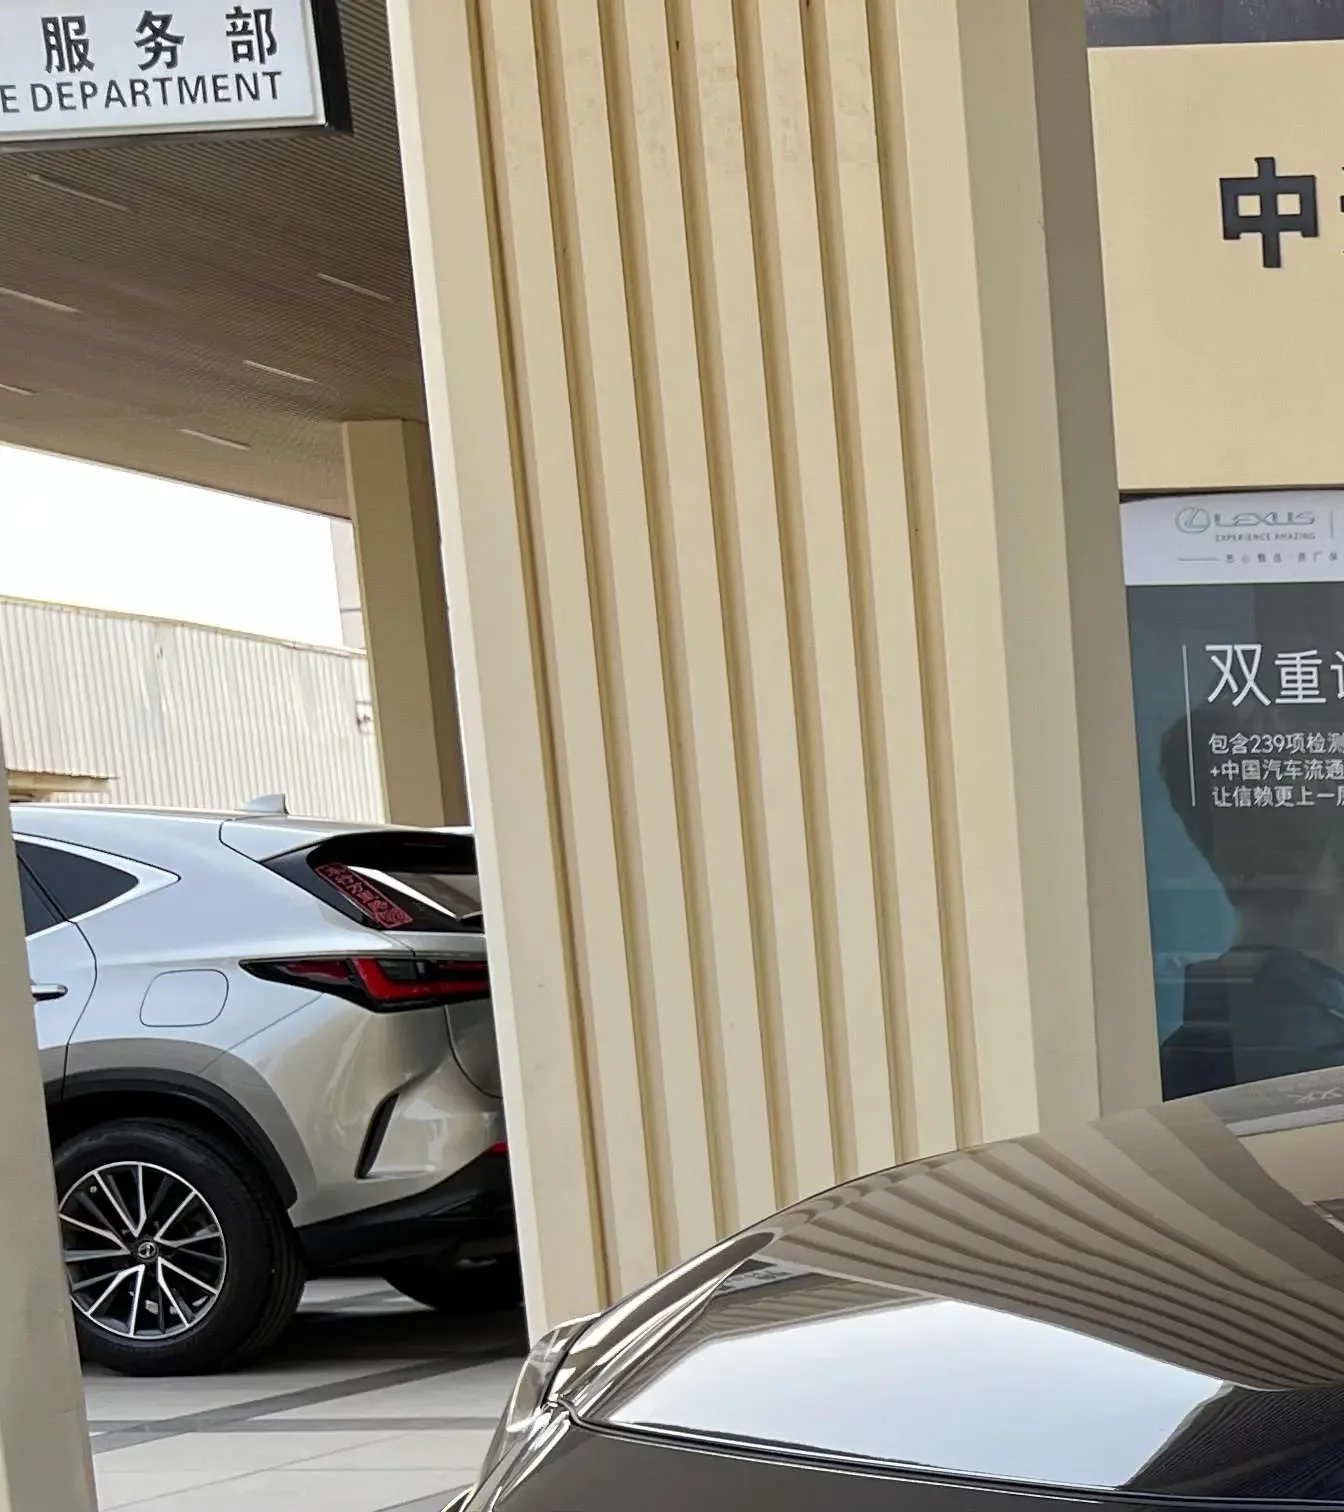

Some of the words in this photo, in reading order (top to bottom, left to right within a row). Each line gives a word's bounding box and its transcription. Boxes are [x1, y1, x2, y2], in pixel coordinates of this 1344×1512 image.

[41, 5, 278, 73] 服务部
[30, 71, 282, 112] DEPARTMENT
[1214, 511, 1316, 528] LEXUS
